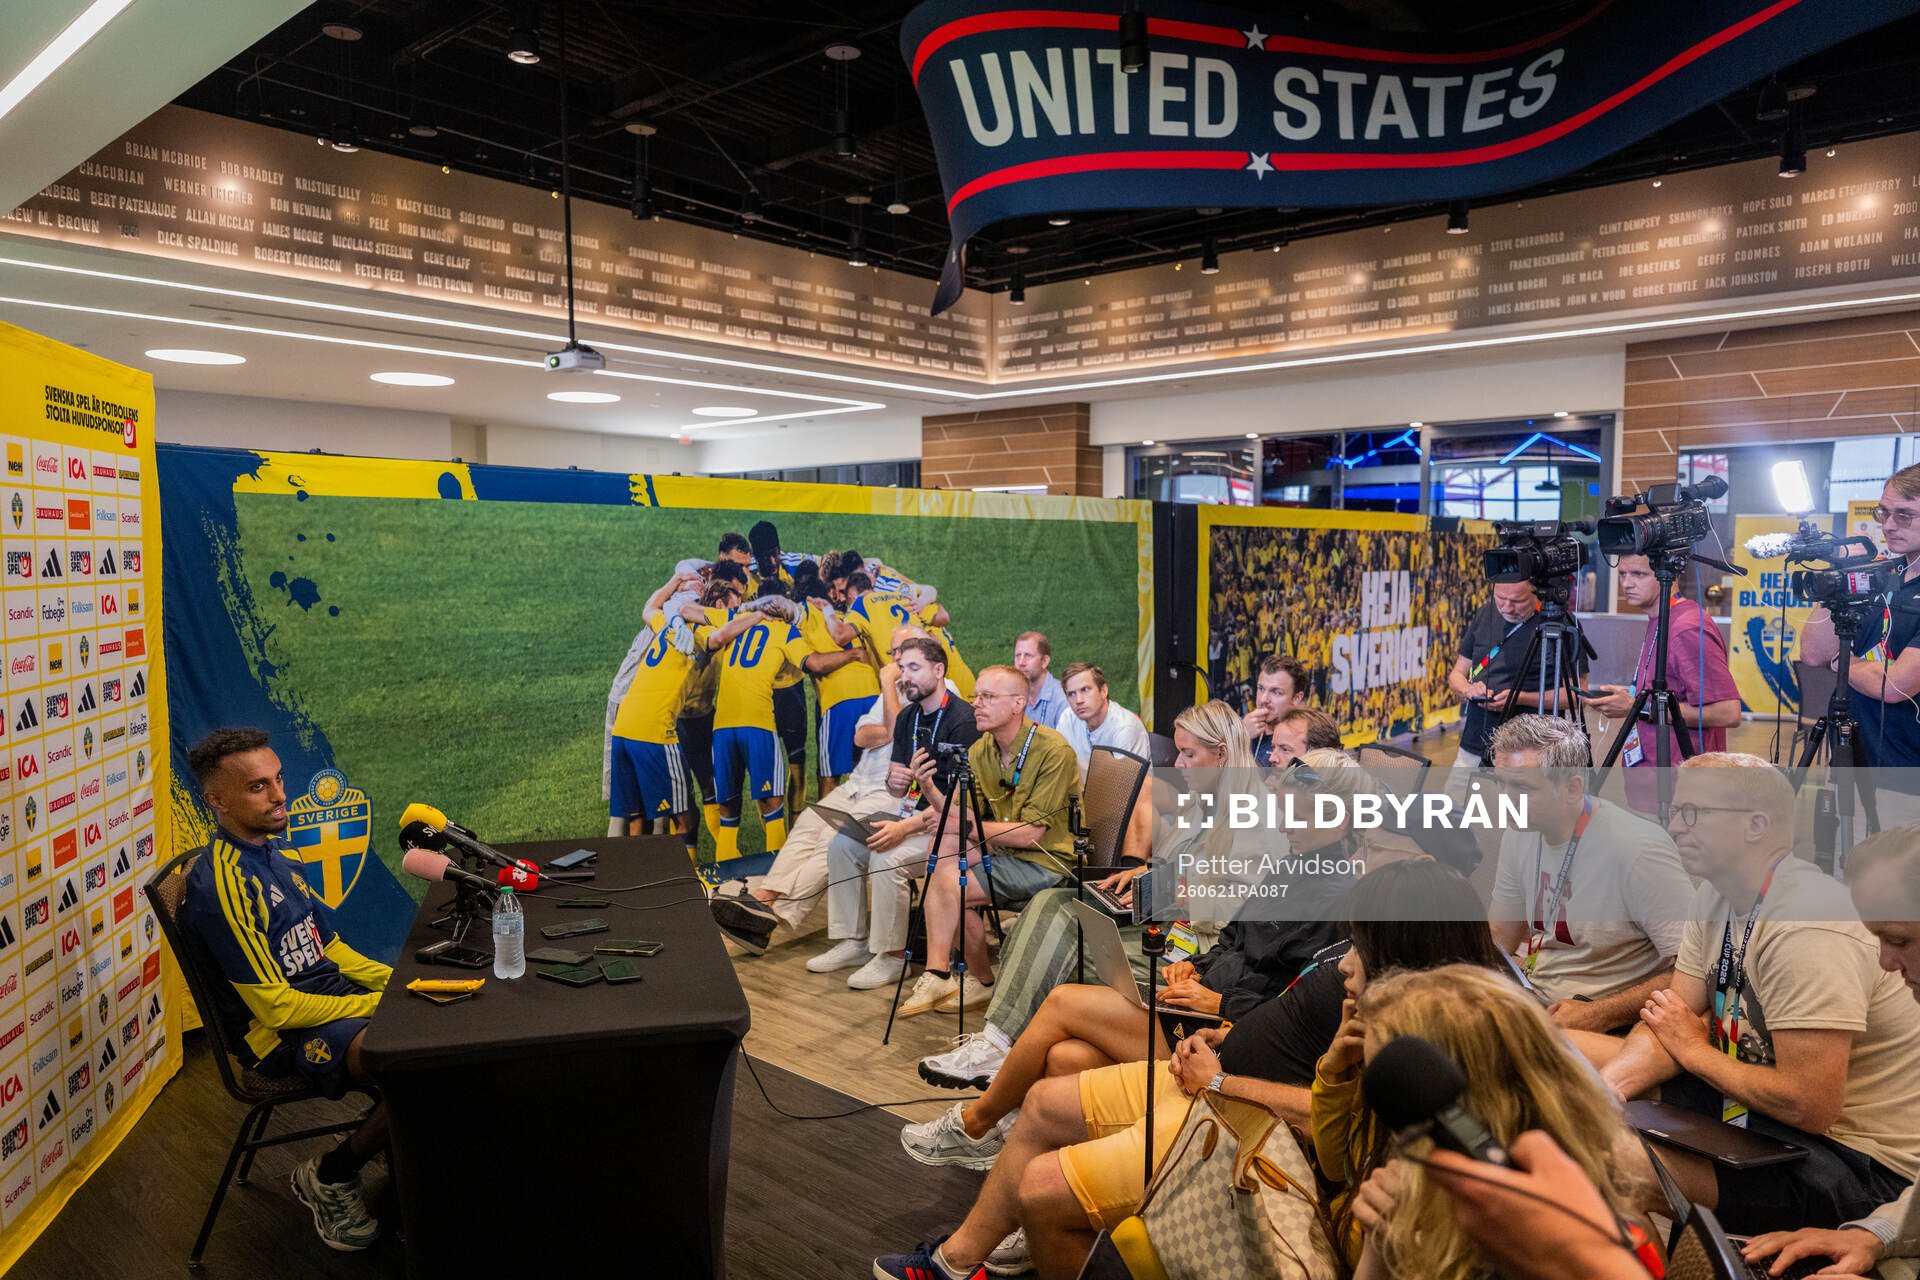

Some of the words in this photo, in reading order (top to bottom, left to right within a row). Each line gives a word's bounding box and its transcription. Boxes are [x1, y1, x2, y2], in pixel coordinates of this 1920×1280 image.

[949, 47, 1239, 147] UNITED
[1273, 48, 1565, 140] STATES
[125, 141, 158, 161] BRIAN
[162, 149, 207, 170] MCBRIDE
[221, 161, 240, 176] BOB
[243, 166, 284, 186] BRADLEY
[295, 177, 336, 197] KRISTINE
[338, 185, 361, 201] LILLY
[423, 203, 451, 220] KELLER
[79, 162, 144, 185] CHACURIAN
[164, 176, 207, 198] WERNER
[270, 197, 290, 212] RON
[292, 202, 332, 221] NEWMAN
[369, 216, 389, 231] PELÉ
[1600, 222, 1622, 235] CLINT
[1623, 216, 1660, 232] DEMPSEY
[1743, 199, 1766, 214] HOPE
[1769, 194, 1793, 209] SOLO
[1802, 188, 1835, 205] MARCO
[1839, 177, 1901, 199] ETCHEVERRY
[90, 191, 117, 209] BERT
[119, 196, 177, 219] PATENAUDE
[186, 208, 216, 226] ALLAN
[219, 215, 255, 233] MCCLAY
[262, 221, 290, 239] JAMES
[293, 227, 324, 245] MOORE
[332, 234, 373, 254] NICOLAAS
[1592, 245, 1616, 259] PETER
[1617, 241, 1650, 255] COLLINS
[1657, 236, 1680, 250] APRIL
[1736, 222, 1775, 239] PATRICK
[1778, 217, 1808, 233] SMITH
[1892, 201, 1918, 216] 2000
[57, 214, 100, 234] BROWN
[157, 230, 184, 247] DICK
[187, 236, 239, 256] SPALDING
[254, 246, 291, 265] ROBERT
[294, 254, 342, 273] MORRISON
[1562, 273, 1576, 285] JOE
[1579, 270, 1603, 283] MACA
[1697, 252, 1726, 267] GEOFF
[1735, 246, 1781, 262] COOMBES
[1800, 239, 1829, 254] ADAM
[1834, 231, 1883, 249] WOLANIN
[1509, 257, 1532, 271] FRANZ
[1533, 250, 1585, 268] BECKENBAUER
[1488, 282, 1514, 295] FRANK
[1632, 284, 1664, 298] GEORGE
[1705, 276, 1727, 289] JACK
[1730, 270, 1778, 287] JOHNSTON
[1795, 263, 1832, 279] JOSEPH
[1836, 258, 1871, 274] BOOTH
[1488, 303, 1511, 316] JAMES
[1514, 298, 1561, 313] ARMSTRONG
[1567, 294, 1587, 306] JOHN
[1602, 289, 1626, 302] WOOD
[45, 385, 75, 407] SVENSKA
[76, 394, 91, 411] SPEL
[91, 395, 101, 413] ÄR
[101, 402, 139, 423] FOTBOLLENS
[46, 404, 70, 424] STOLTA
[72, 411, 124, 435] HUVUDSPONSOR
[36, 455, 58, 473] Coca-Cola
[68, 457, 86, 480] ICA
[93, 465, 116, 478] BAUHAUS
[36, 508, 63, 519] BAUHAUS
[121, 512, 140, 524] Scandic
[7, 563, 20, 575] SPEL
[70, 562, 82, 573] SPEL
[123, 560, 133, 570] SPEL
[1760, 572, 1793, 589] HEJ
[9, 606, 34, 621] Scandic
[42, 605, 65, 622] Fabege
[71, 602, 94, 614] Folksam
[101, 595, 117, 615] ICA
[1362, 570, 1411, 628] HEJA
[11, 655, 35, 675] Coca-Cola
[99, 642, 122, 655] BAUHAUS
[729, 624, 770, 668] 10
[47, 706, 59, 719] SPEL
[103, 690, 113, 702] SPEL
[17, 754, 39, 780] ICA
[47, 745, 72, 764] Scandic
[129, 722, 147, 737] Fabege
[49, 794, 76, 812] BAUHAUS
[298, 805, 359, 825] SVERIGE
[84, 823, 102, 848] ICA
[108, 811, 130, 830] Scandic
[86, 880, 97, 892] SPEL
[136, 848, 146, 861] SPEL
[1561, 854, 1573, 877] WORLD
[25, 915, 38, 930] SPEL
[279, 911, 315, 957] SVENS
[62, 928, 80, 956] ICA
[1723, 944, 1732, 958] CUP
[283, 939, 320, 977] SPEL
[1720, 960, 1729, 984] 2026
[62, 979, 84, 1004] Fabege
[30, 1000, 55, 1027] Scandic
[33, 1048, 59, 1076] Folksam
[69, 1082, 81, 1098] SPEL
[2, 1142, 17, 1161] SPEL
[5, 1175, 32, 1208] Scandic
[71, 1115, 94, 1144] Fabege
